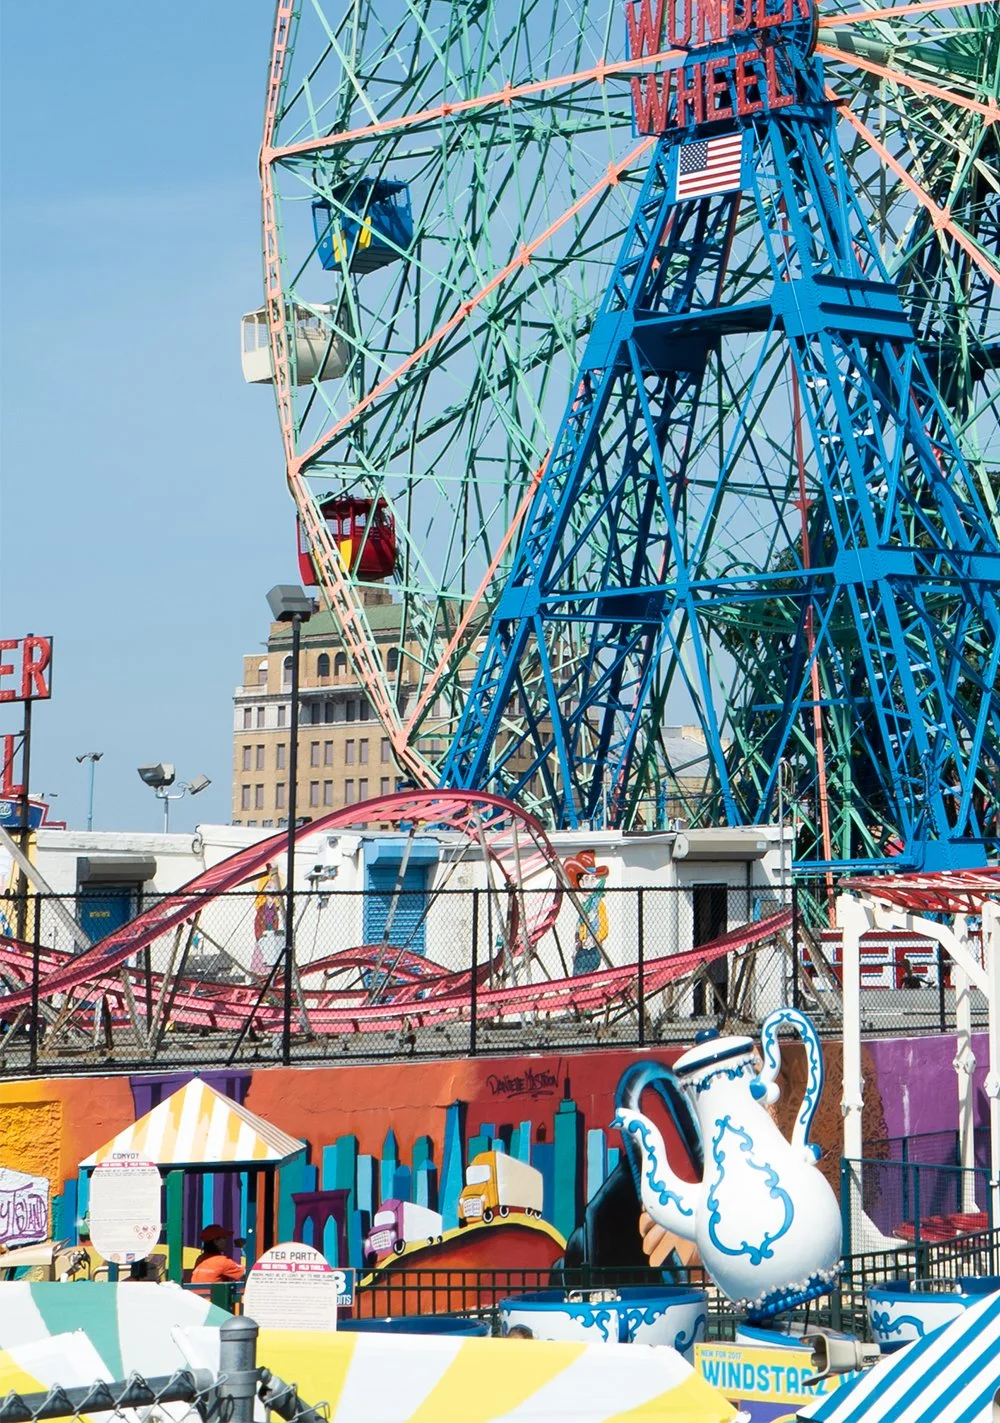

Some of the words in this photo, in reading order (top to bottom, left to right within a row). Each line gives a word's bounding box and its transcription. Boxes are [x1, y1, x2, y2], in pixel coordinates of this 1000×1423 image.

[630, 47, 794, 132] WHEEL
[270, 1252, 286, 1260] TEA
[290, 1252, 318, 1261] PARTY
